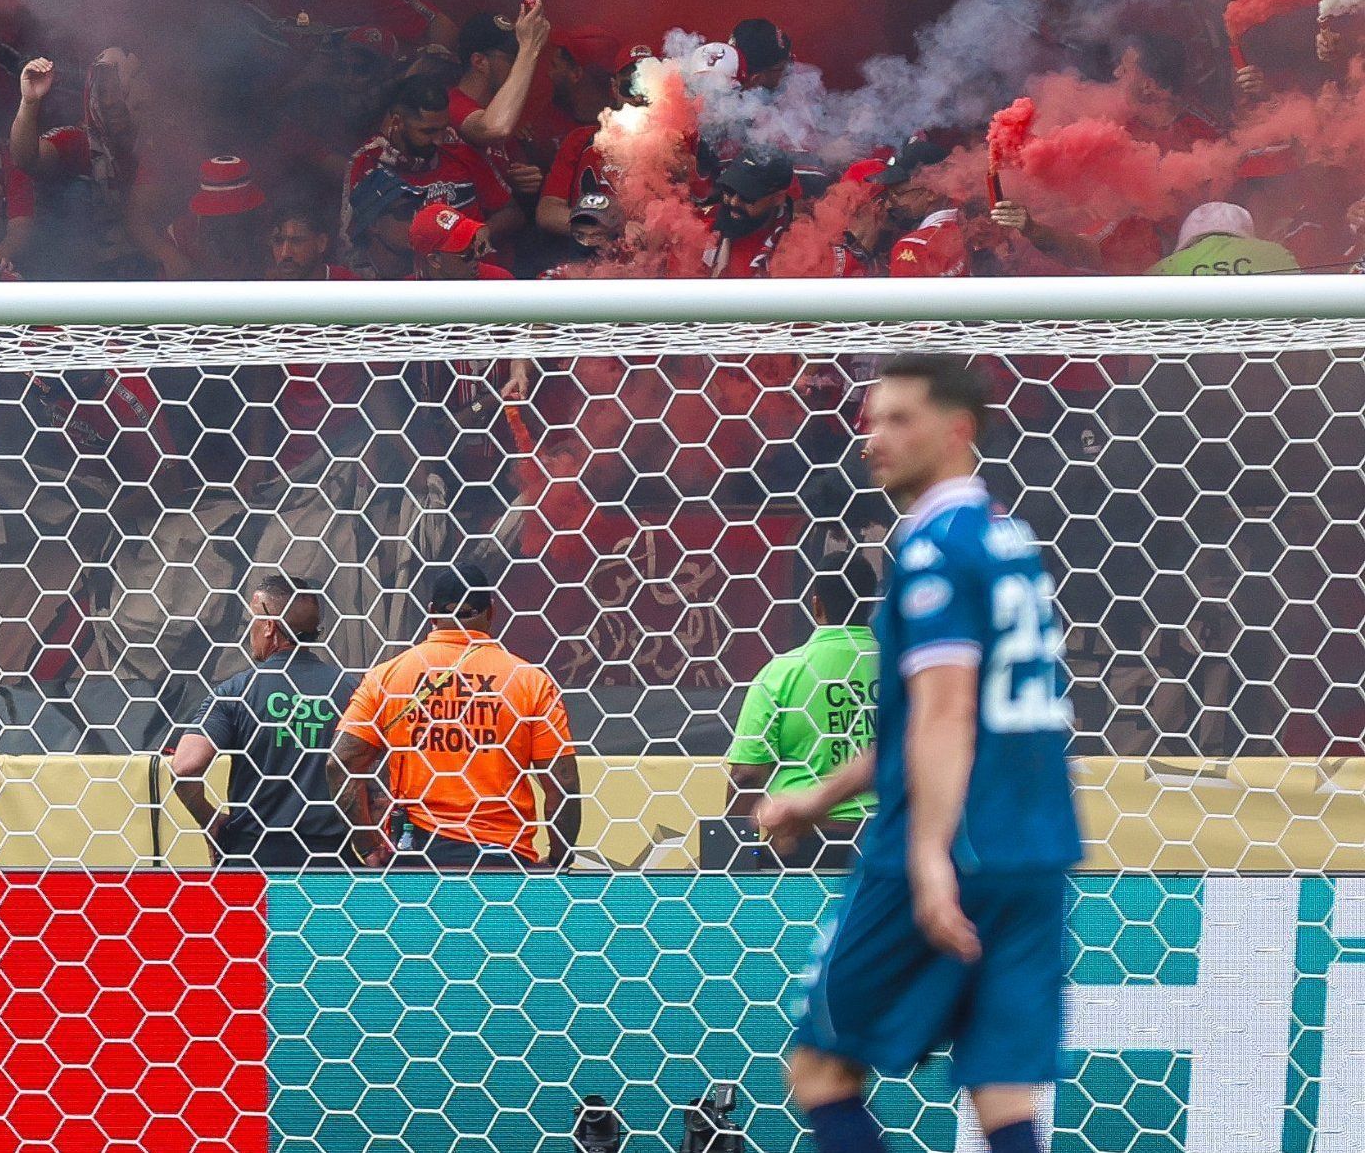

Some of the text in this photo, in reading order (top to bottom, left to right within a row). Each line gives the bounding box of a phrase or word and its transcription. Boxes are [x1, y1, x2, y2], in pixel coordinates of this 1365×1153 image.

[412, 672, 497, 697] APEX
[267, 692, 334, 721] CSC
[407, 700, 503, 726] SECURITY
[276, 721, 324, 748] FIT
[828, 710, 878, 735] EVEN
[411, 726, 497, 753] GROUP
